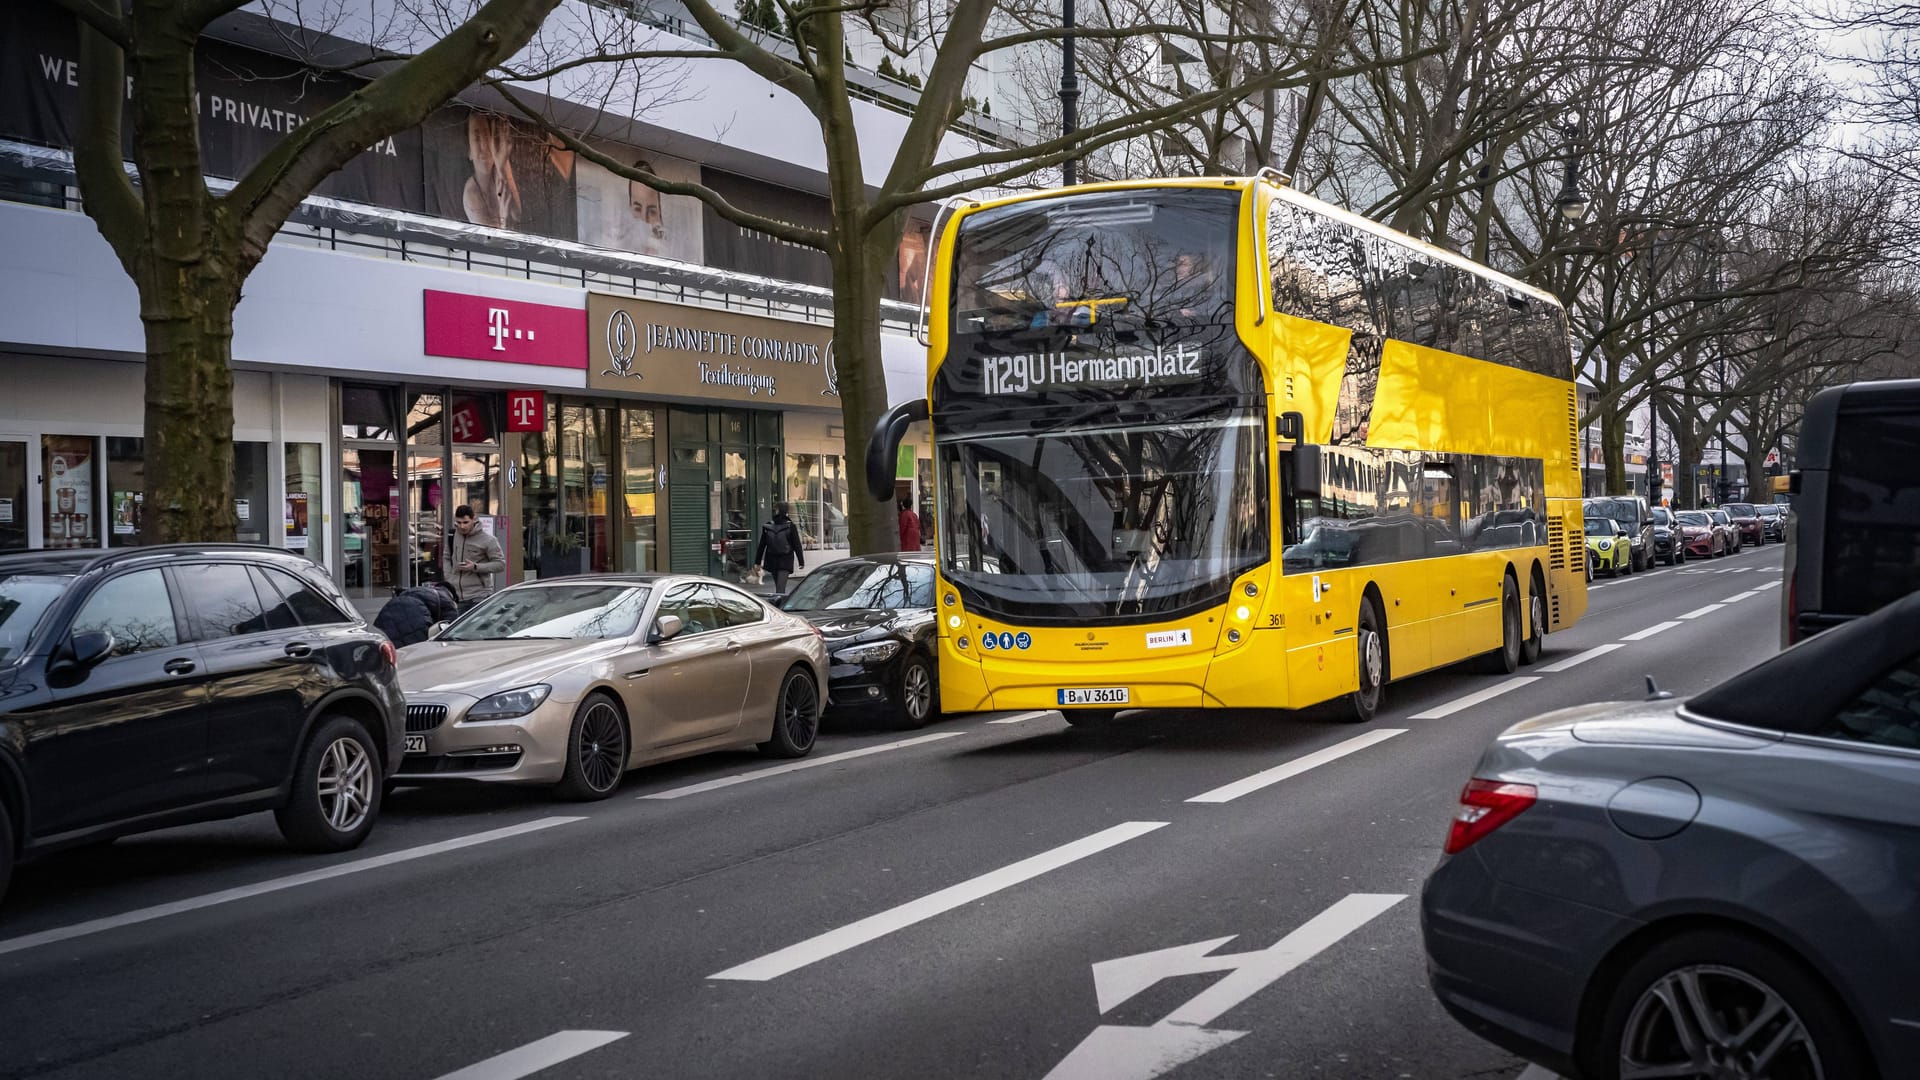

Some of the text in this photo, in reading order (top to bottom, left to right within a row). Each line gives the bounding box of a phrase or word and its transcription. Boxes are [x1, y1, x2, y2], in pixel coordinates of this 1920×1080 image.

[645, 323, 819, 366] JEANNETTE CONRADTS
[698, 360, 776, 396] Textilreinigung
[983, 343, 1200, 395] M29 U Hermannplatz
[513, 397, 535, 425] T
[1149, 636, 1174, 644] BERLIN
[1068, 689, 1123, 703] B V 3610
